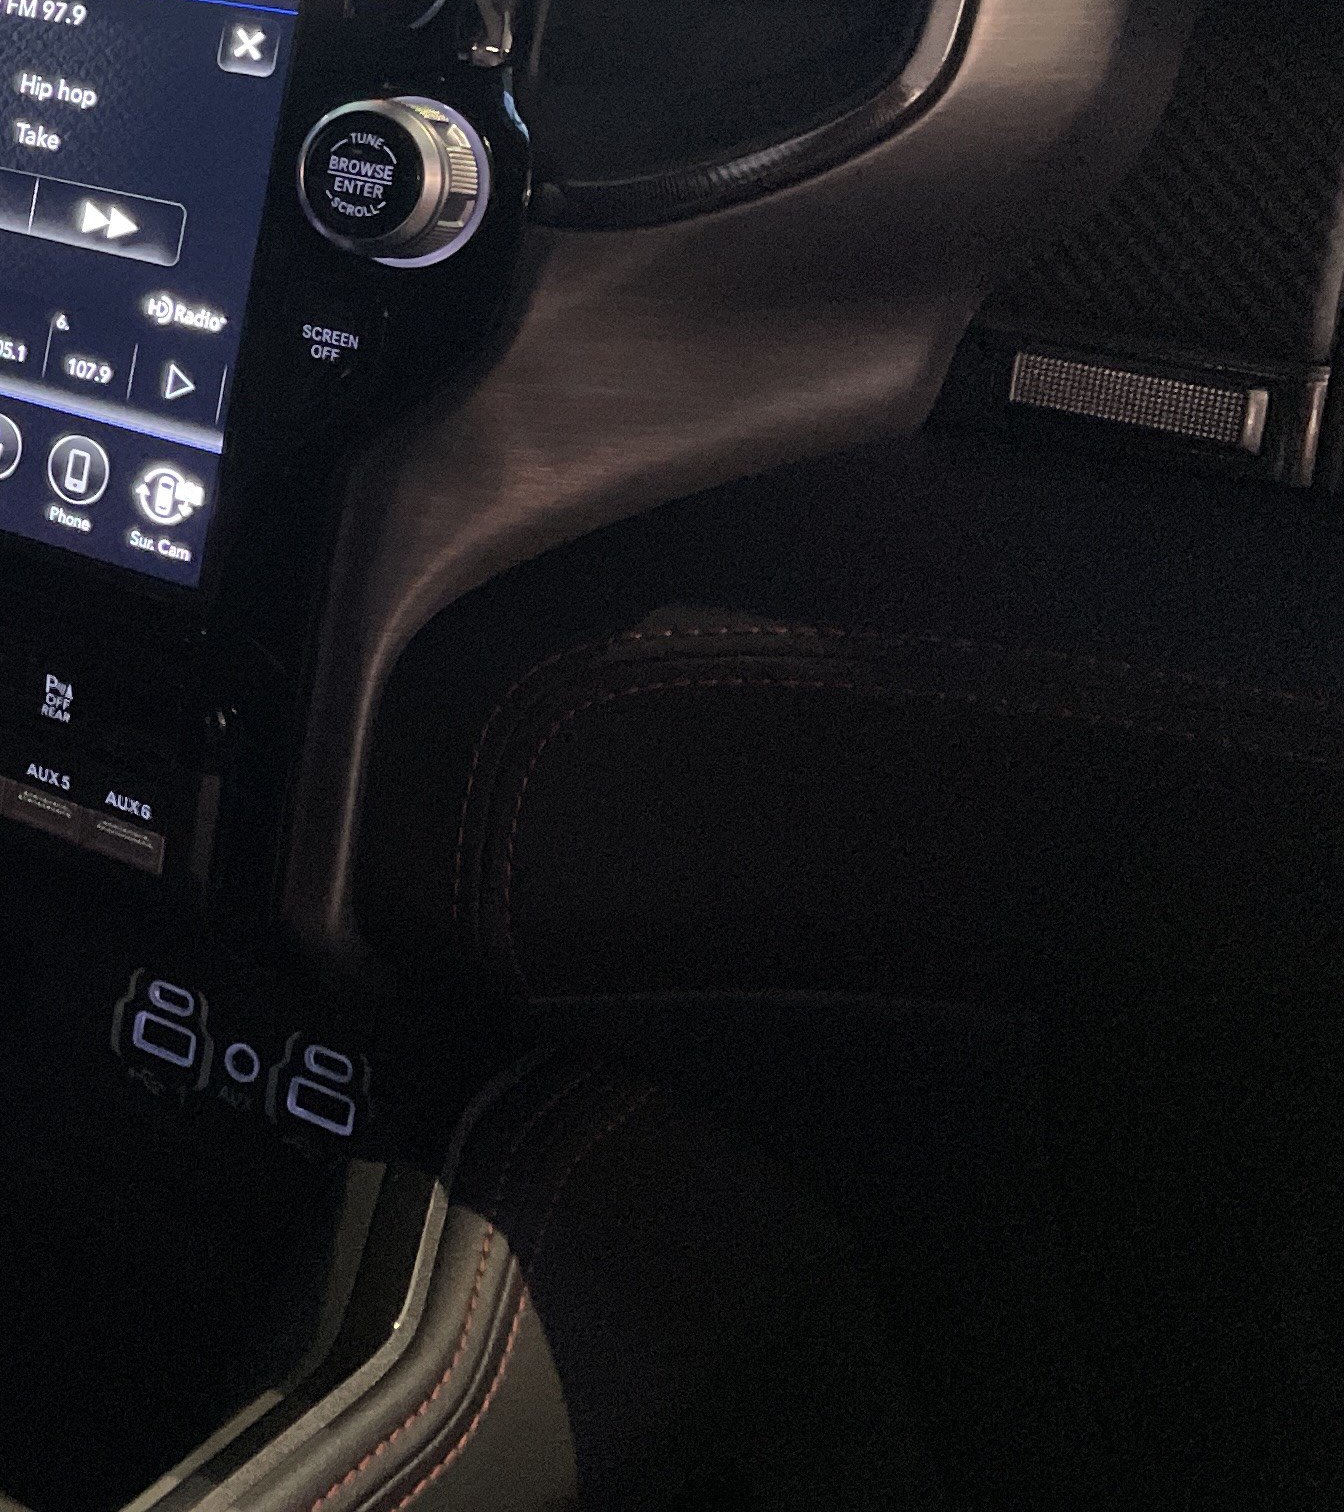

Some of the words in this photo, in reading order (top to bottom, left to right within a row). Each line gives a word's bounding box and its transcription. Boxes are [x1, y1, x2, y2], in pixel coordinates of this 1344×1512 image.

[41, 0, 88, 27] 97.9
[19, 72, 55, 102] Hip
[58, 79, 98, 110] hop
[16, 121, 61, 152] Take
[350, 132, 385, 150] TUNE
[328, 155, 395, 180] BROWSE
[333, 177, 385, 200] ENTER
[330, 198, 380, 218] SCROLL
[55, 314, 70, 331] 6.
[302, 324, 359, 350] SCREEN
[310, 344, 341, 362] OFF
[68, 357, 113, 384] 107.9
[48, 505, 92, 532] Phone
[129, 530, 155, 551] Sur.
[157, 538, 192, 563] Cam
[41, 703, 72, 724] REAR
[45, 692, 72, 710] OFF
[26, 762, 59, 786] AUX
[59, 773, 72, 790] 5
[104, 790, 139, 816] AUX
[139, 803, 153, 821] 6
